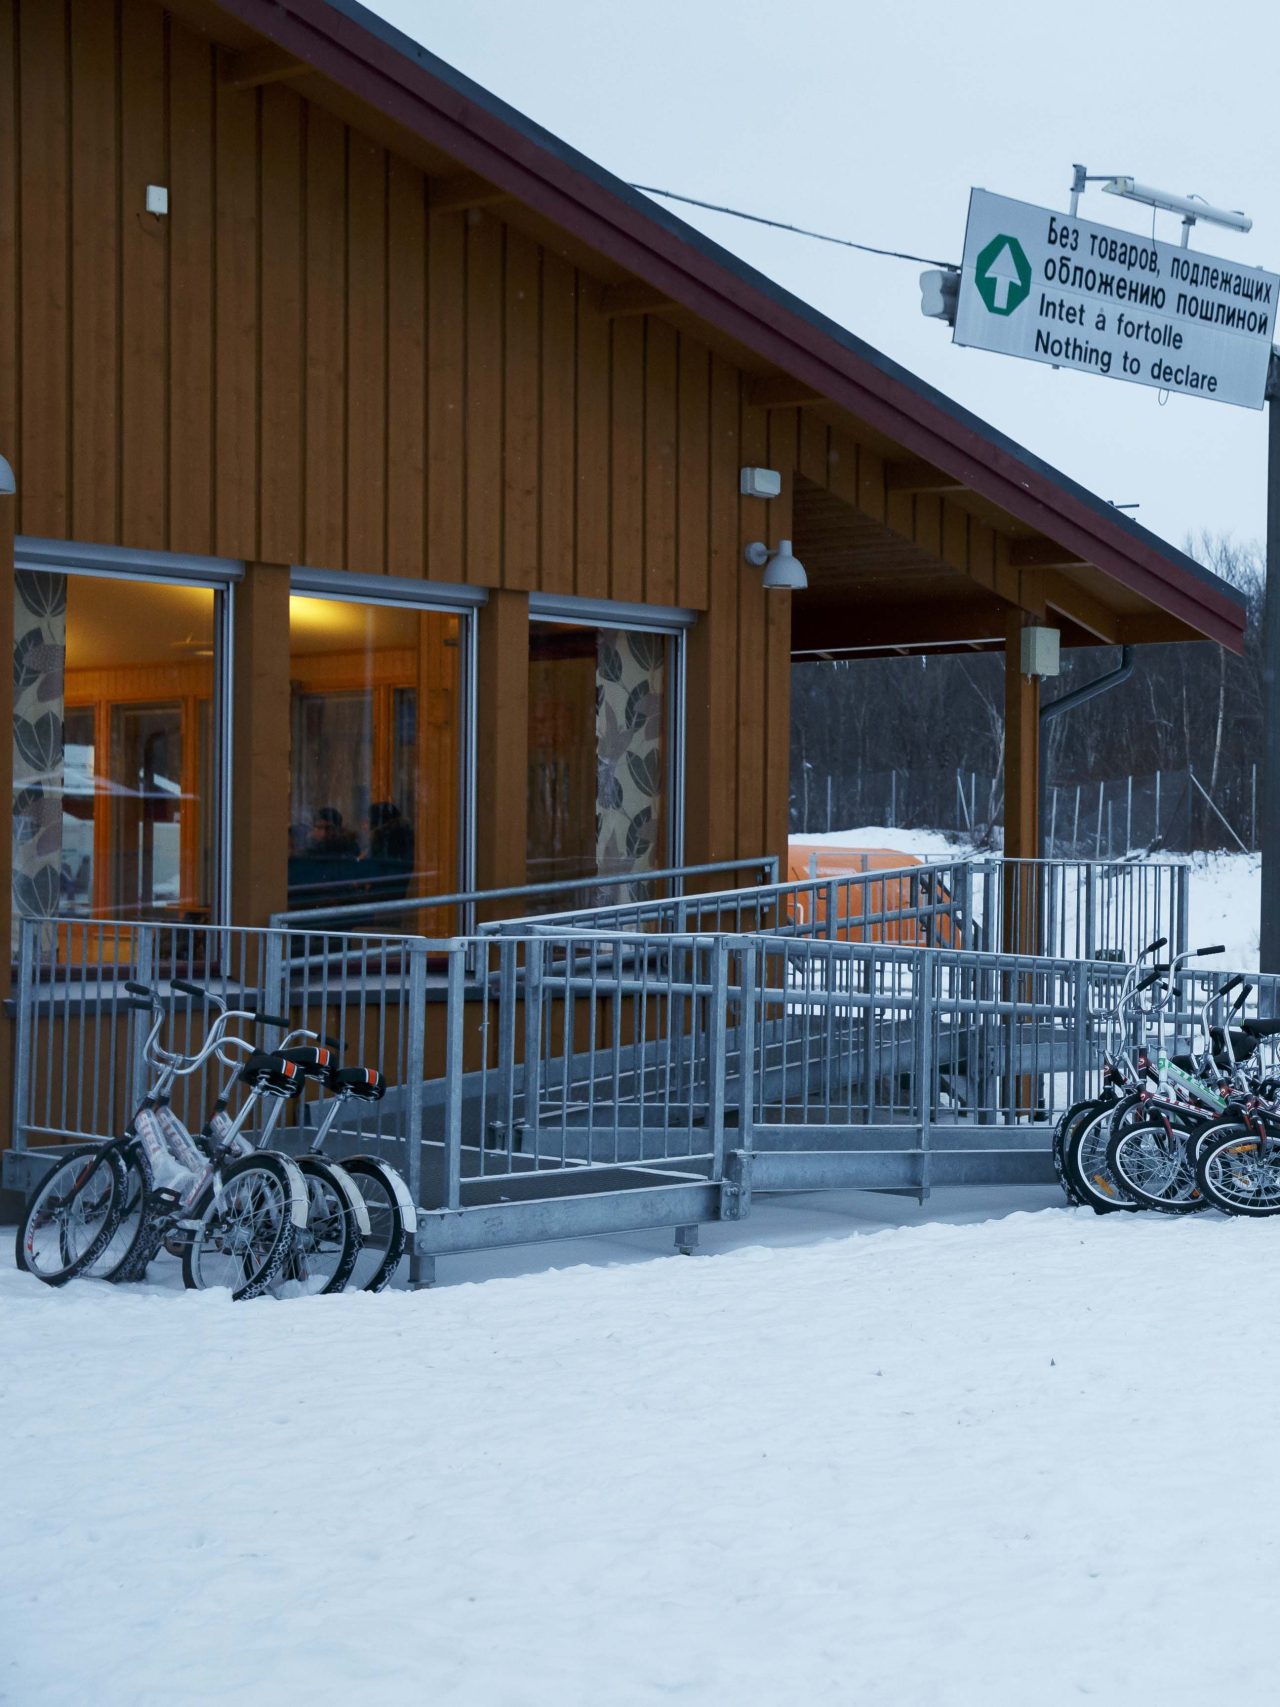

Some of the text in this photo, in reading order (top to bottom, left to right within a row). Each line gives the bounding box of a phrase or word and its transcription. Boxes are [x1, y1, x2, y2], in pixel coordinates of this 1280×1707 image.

[1044, 256, 1269, 335] обложению пошлиной
[1048, 216, 1272, 304] Без товаров, подлежащих
[1039, 293, 1086, 326] Intet
[1116, 313, 1183, 350] fortolle
[1034, 329, 1218, 393] Nothing to declare
